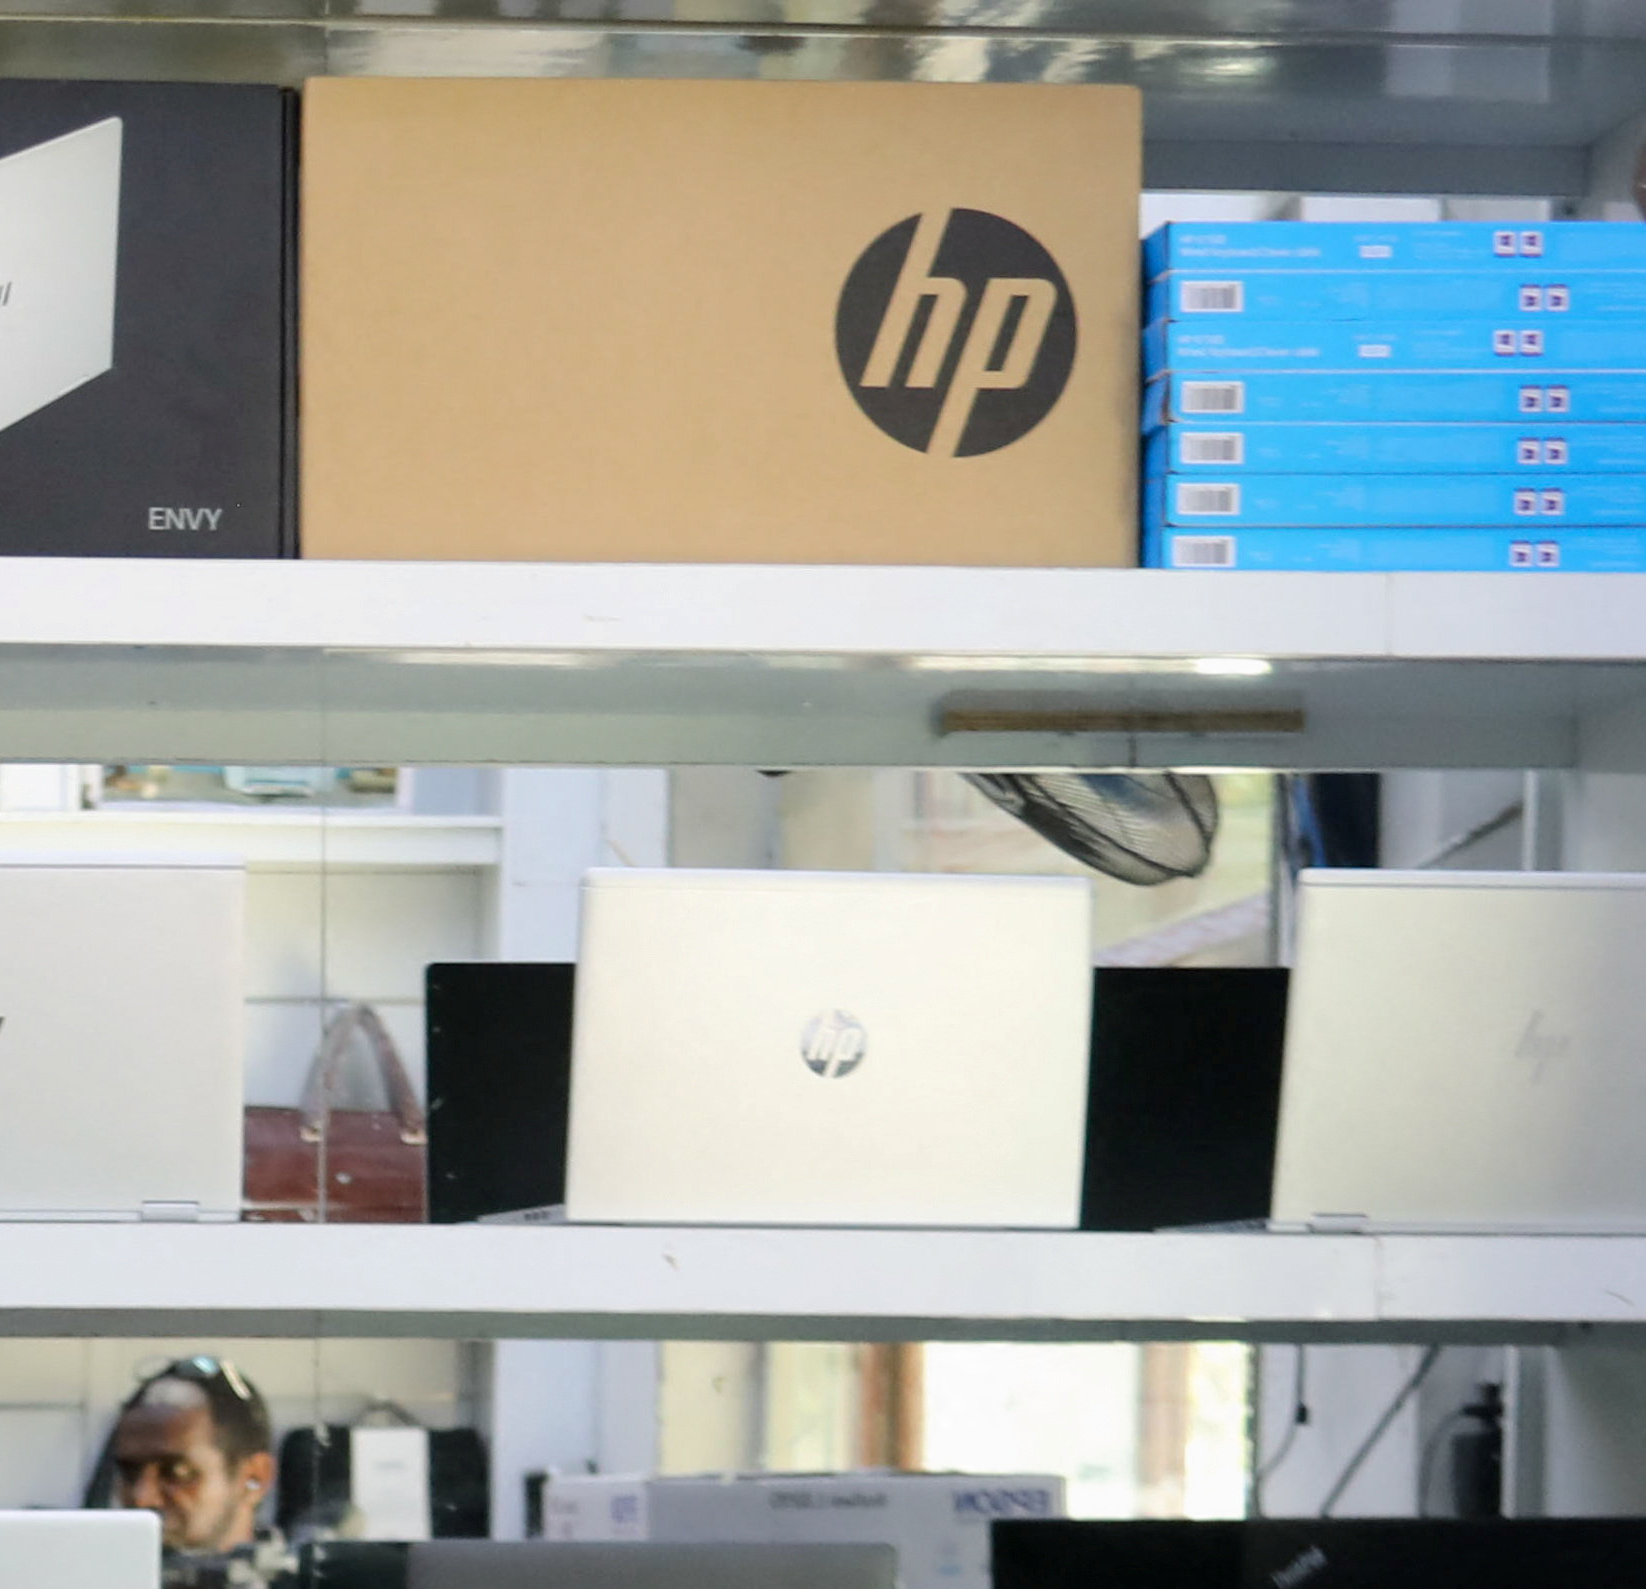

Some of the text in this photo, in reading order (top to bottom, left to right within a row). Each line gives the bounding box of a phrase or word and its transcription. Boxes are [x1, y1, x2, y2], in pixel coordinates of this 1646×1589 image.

[859, 207, 1058, 458] hp
[148, 507, 223, 532] ENVY
[807, 1009, 862, 1078] hp
